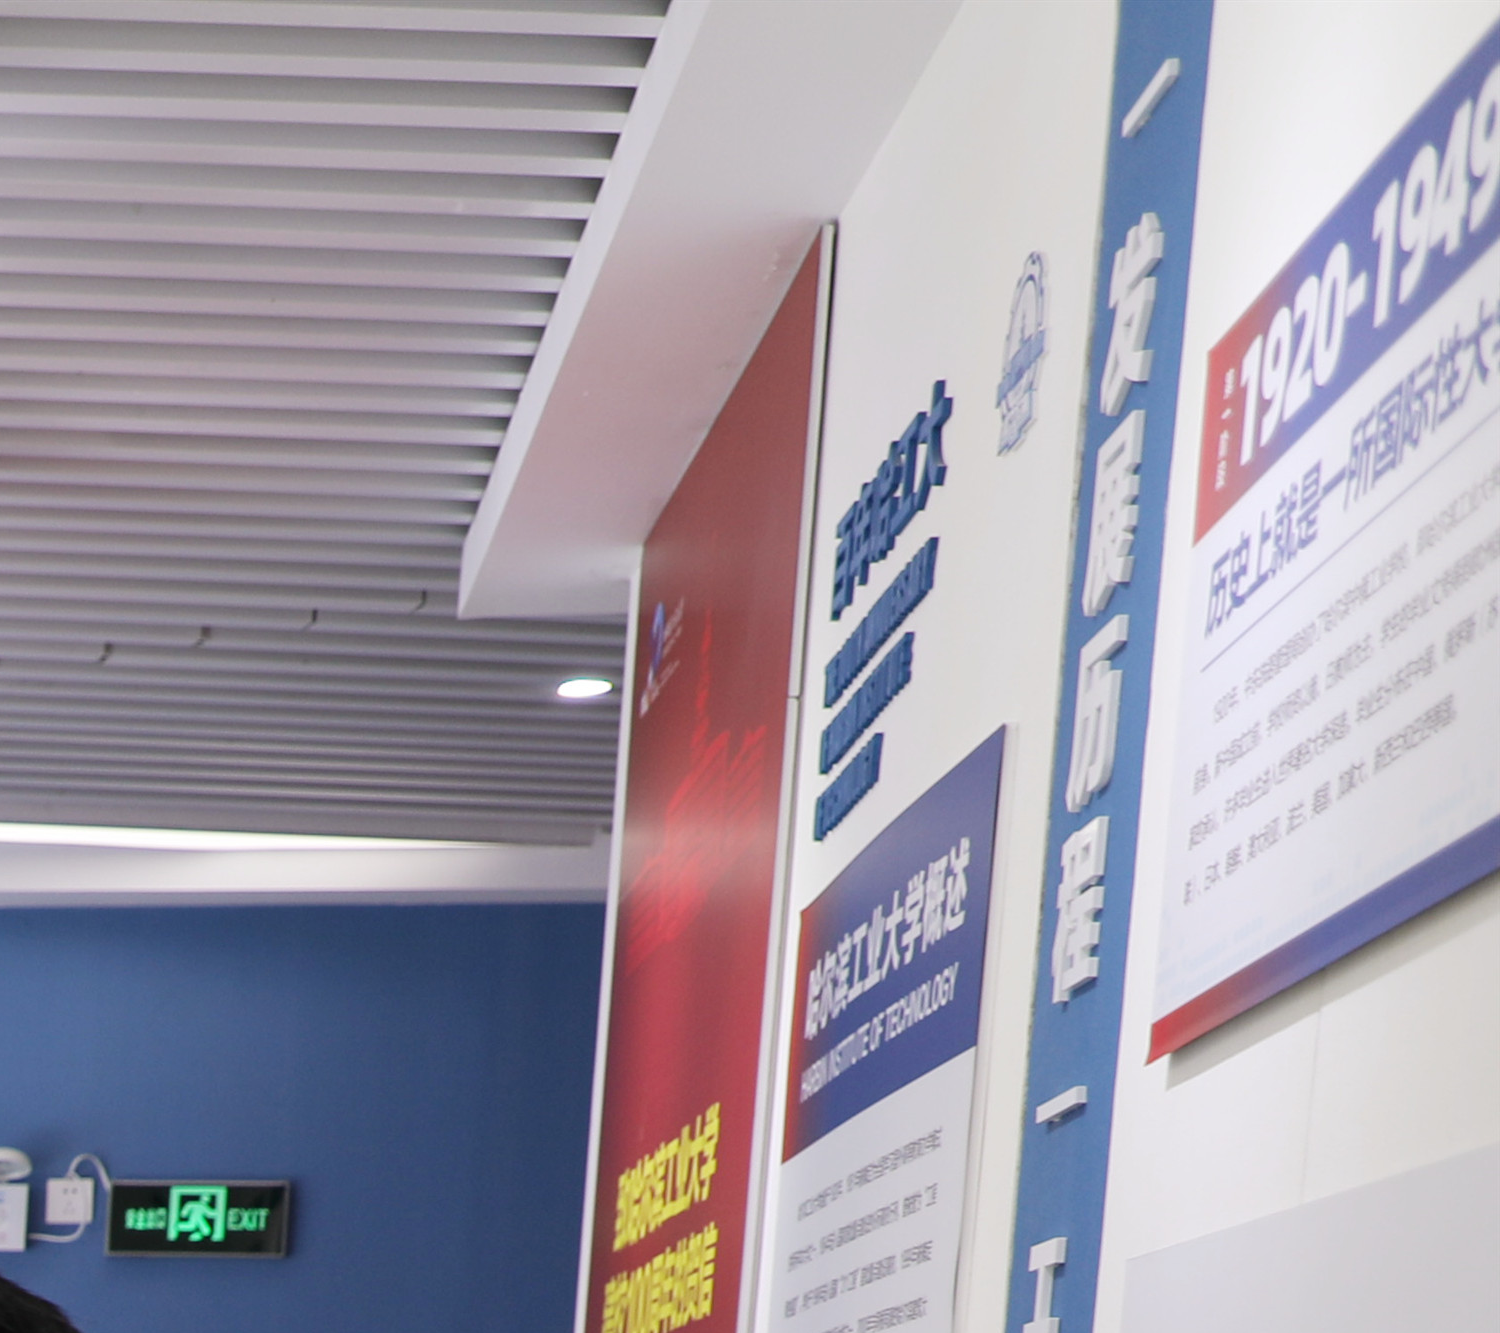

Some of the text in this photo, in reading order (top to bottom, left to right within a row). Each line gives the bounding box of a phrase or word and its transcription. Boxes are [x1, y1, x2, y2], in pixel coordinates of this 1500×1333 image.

[1240, 62, 1500, 467] 1920-1949
[1204, 295, 1500, 641] 历史上就是一所国际性大
[1051, 212, 1166, 1004] 发展历程
[804, 837, 970, 1041] 哈尔滨工业大学概述
[868, 1011, 884, 1052] OF
[883, 962, 960, 1042] TECHNOLOGY
[227, 1208, 269, 1231] EXIT
